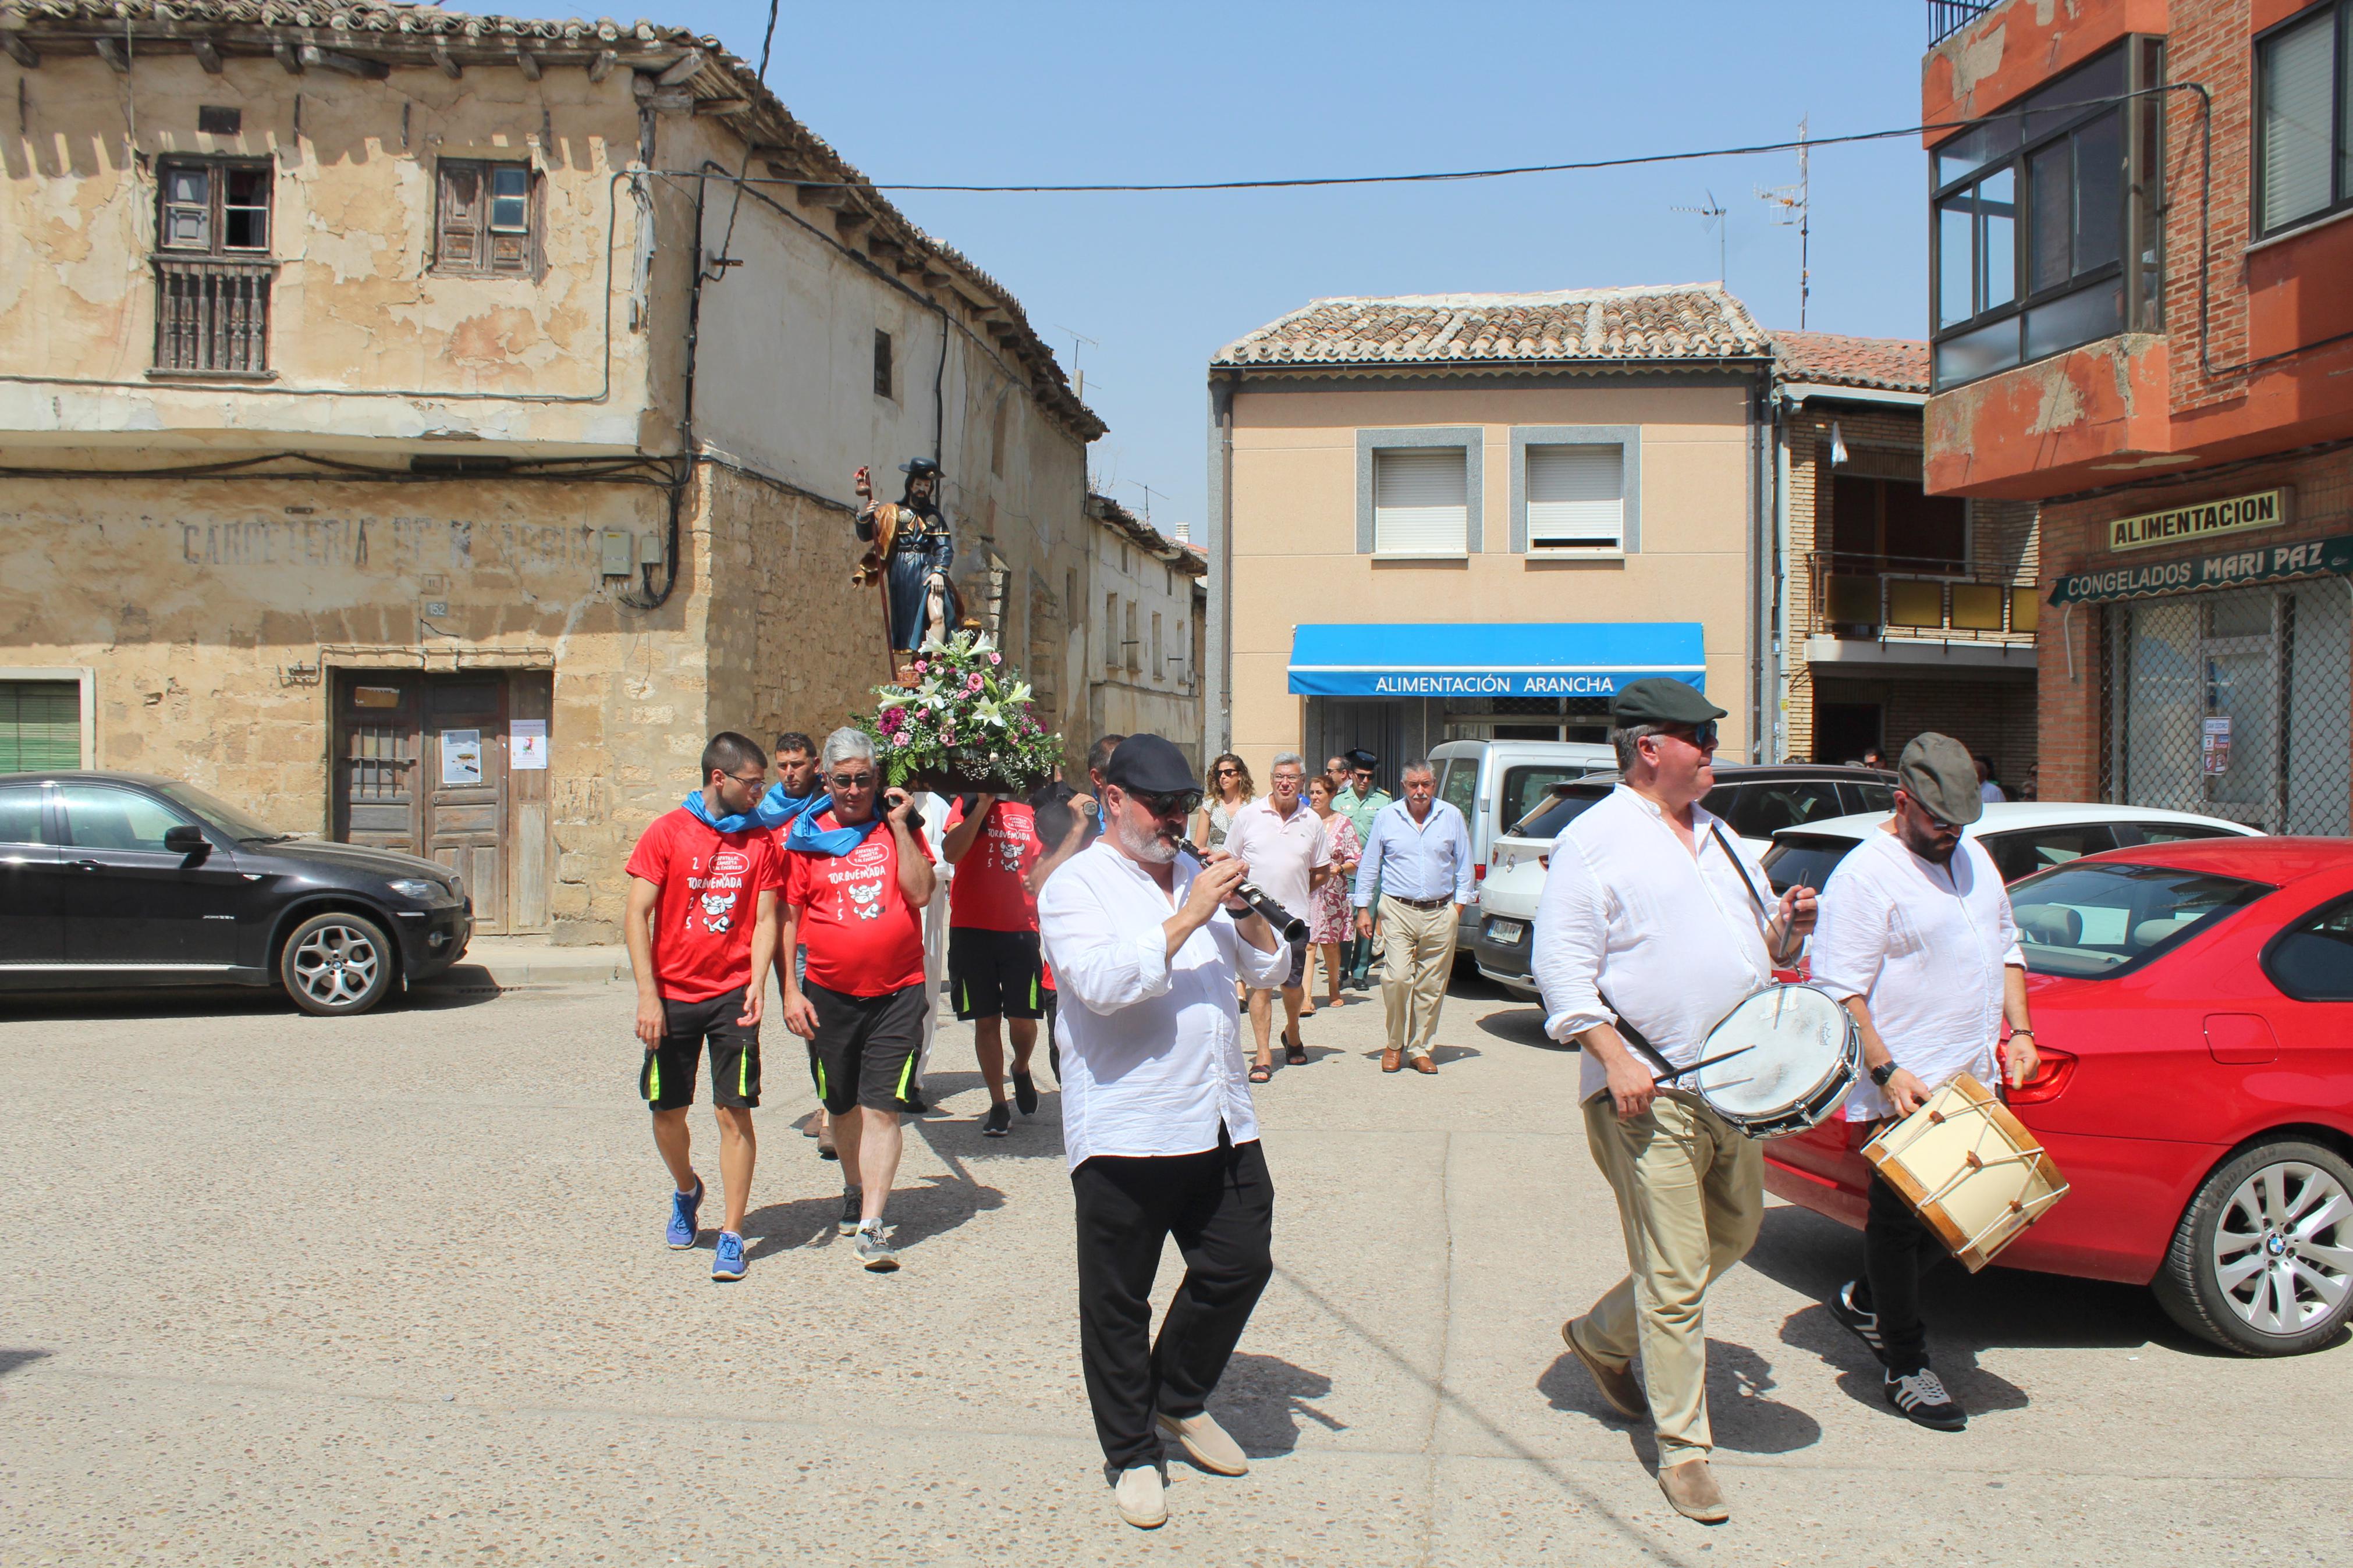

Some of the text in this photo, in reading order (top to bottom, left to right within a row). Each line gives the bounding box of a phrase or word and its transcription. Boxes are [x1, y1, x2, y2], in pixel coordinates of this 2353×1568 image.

[2114, 495, 2273, 545] ALIMENTACION
[2068, 542, 2324, 596] CONGELADOS MARI PAZ
[428, 604, 445, 615] 152
[1375, 674, 1614, 693] ALIMENTACIÓN ARANCHA
[991, 815, 995, 824] 2
[988, 829, 1030, 842] TORQUEMADA
[989, 843, 994, 853] 2
[693, 857, 700, 870] 2
[831, 856, 837, 867] 2
[988, 858, 992, 867] 5
[828, 865, 886, 884] TORQUEMADA
[687, 876, 742, 890] TORQUEMADA
[688, 897, 694, 909] 2
[837, 890, 843, 903] 2
[837, 908, 843, 920] 5
[686, 916, 692, 929] 5
